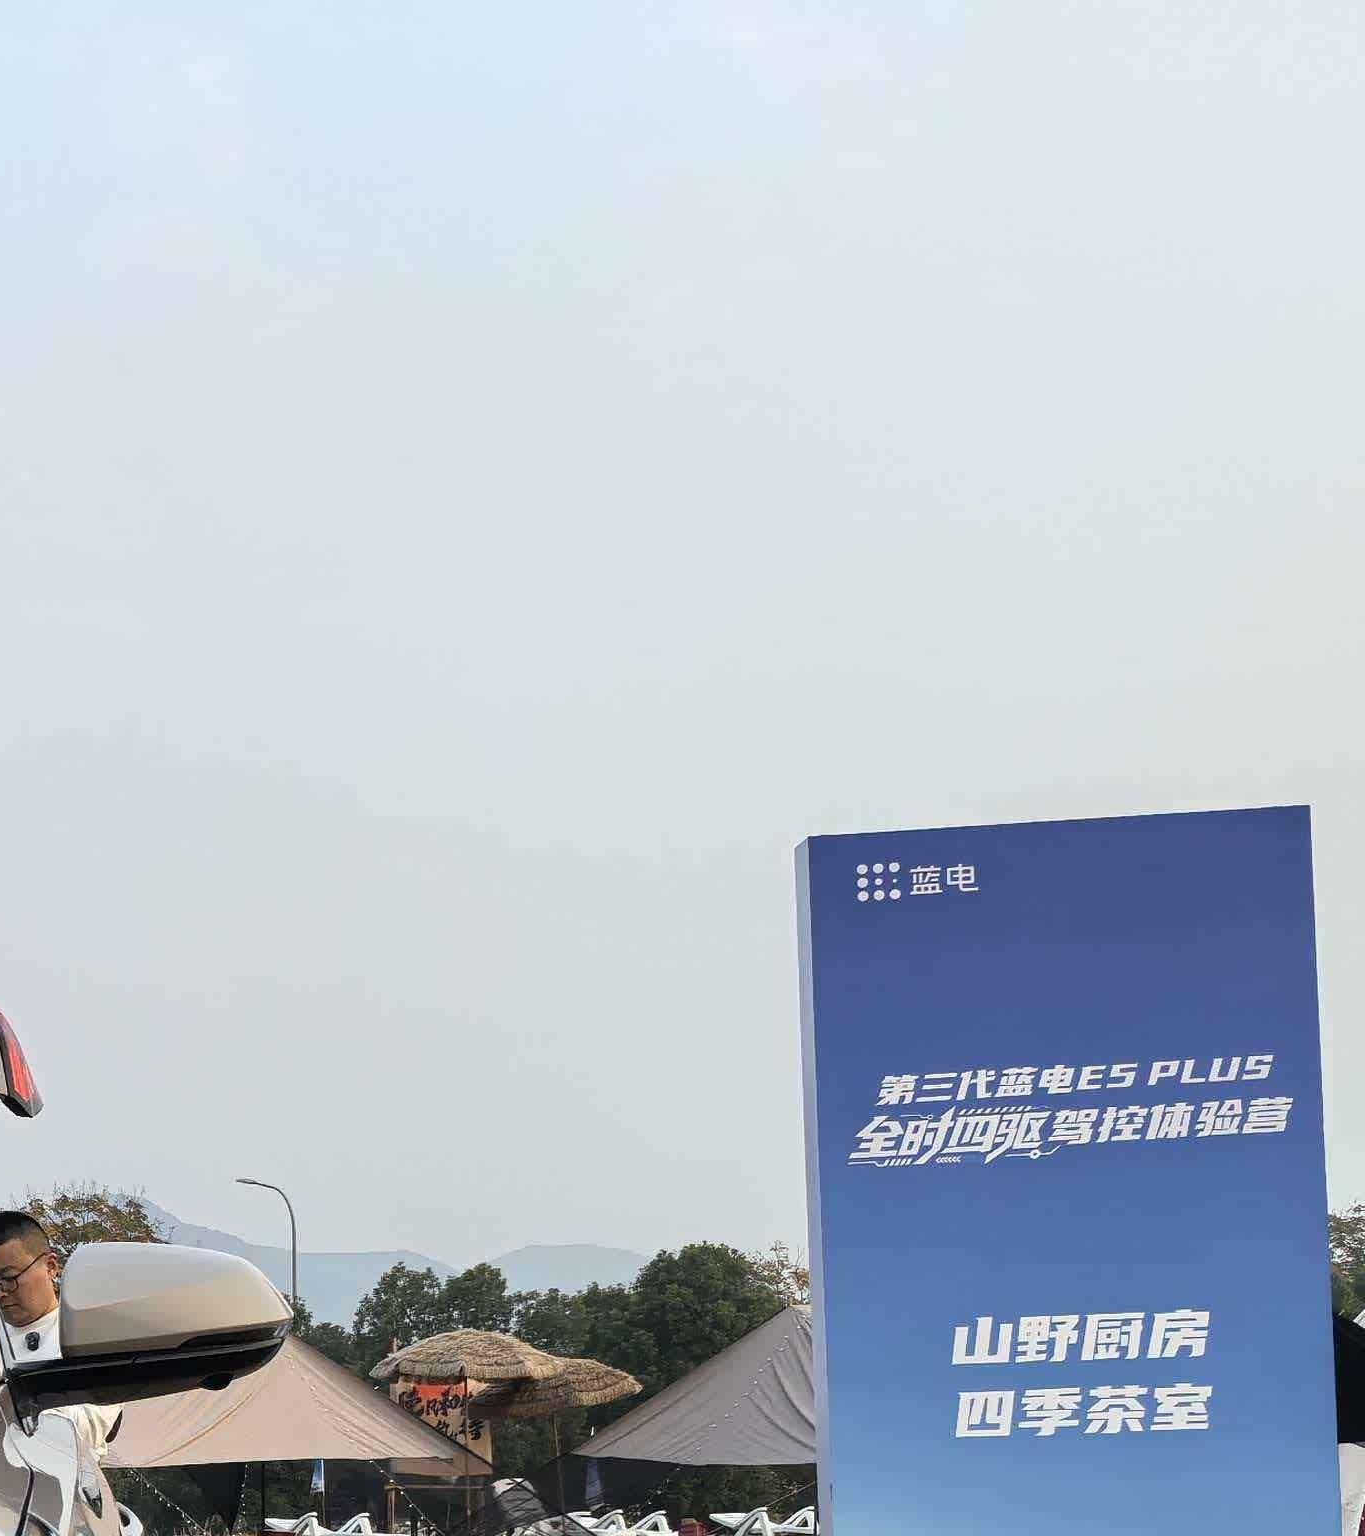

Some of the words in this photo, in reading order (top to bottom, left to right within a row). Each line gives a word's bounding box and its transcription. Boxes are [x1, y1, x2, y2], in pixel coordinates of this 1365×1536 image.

[909, 863, 979, 896] 蓝电
[875, 1063, 1139, 1106] 第三代蓝电E5
[1147, 1054, 1275, 1086] PLUS
[847, 1096, 1294, 1167] 全时四驱驾控体验营
[951, 1308, 1210, 1366] 山野厨房
[955, 1382, 1213, 1438] 四季茶室
